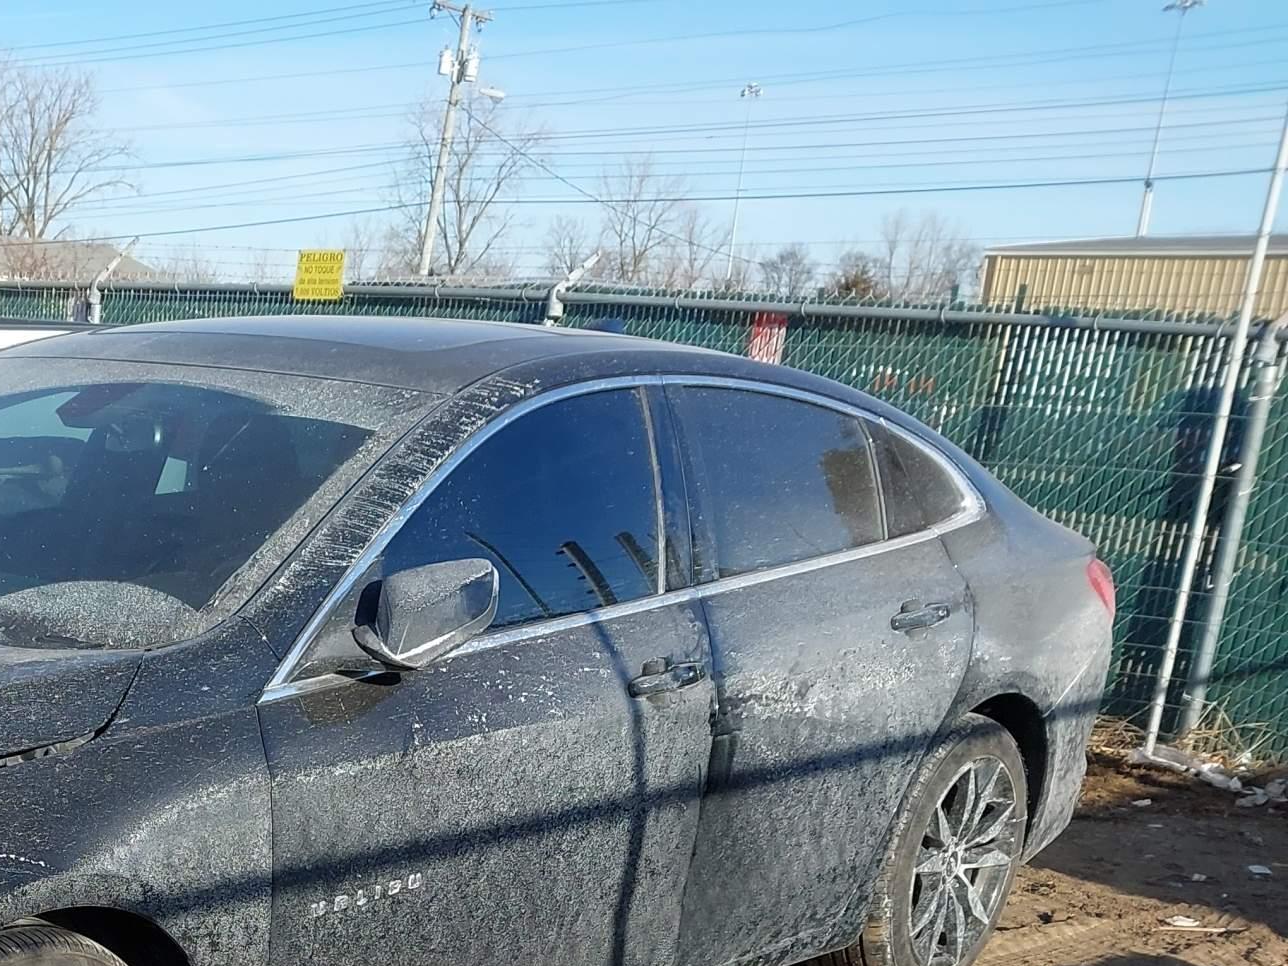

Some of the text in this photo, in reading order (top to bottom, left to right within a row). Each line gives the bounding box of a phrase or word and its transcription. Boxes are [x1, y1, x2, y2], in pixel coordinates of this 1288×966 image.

[299, 252, 344, 263] PELIGRO
[304, 265, 335, 274] NO TOQUE
